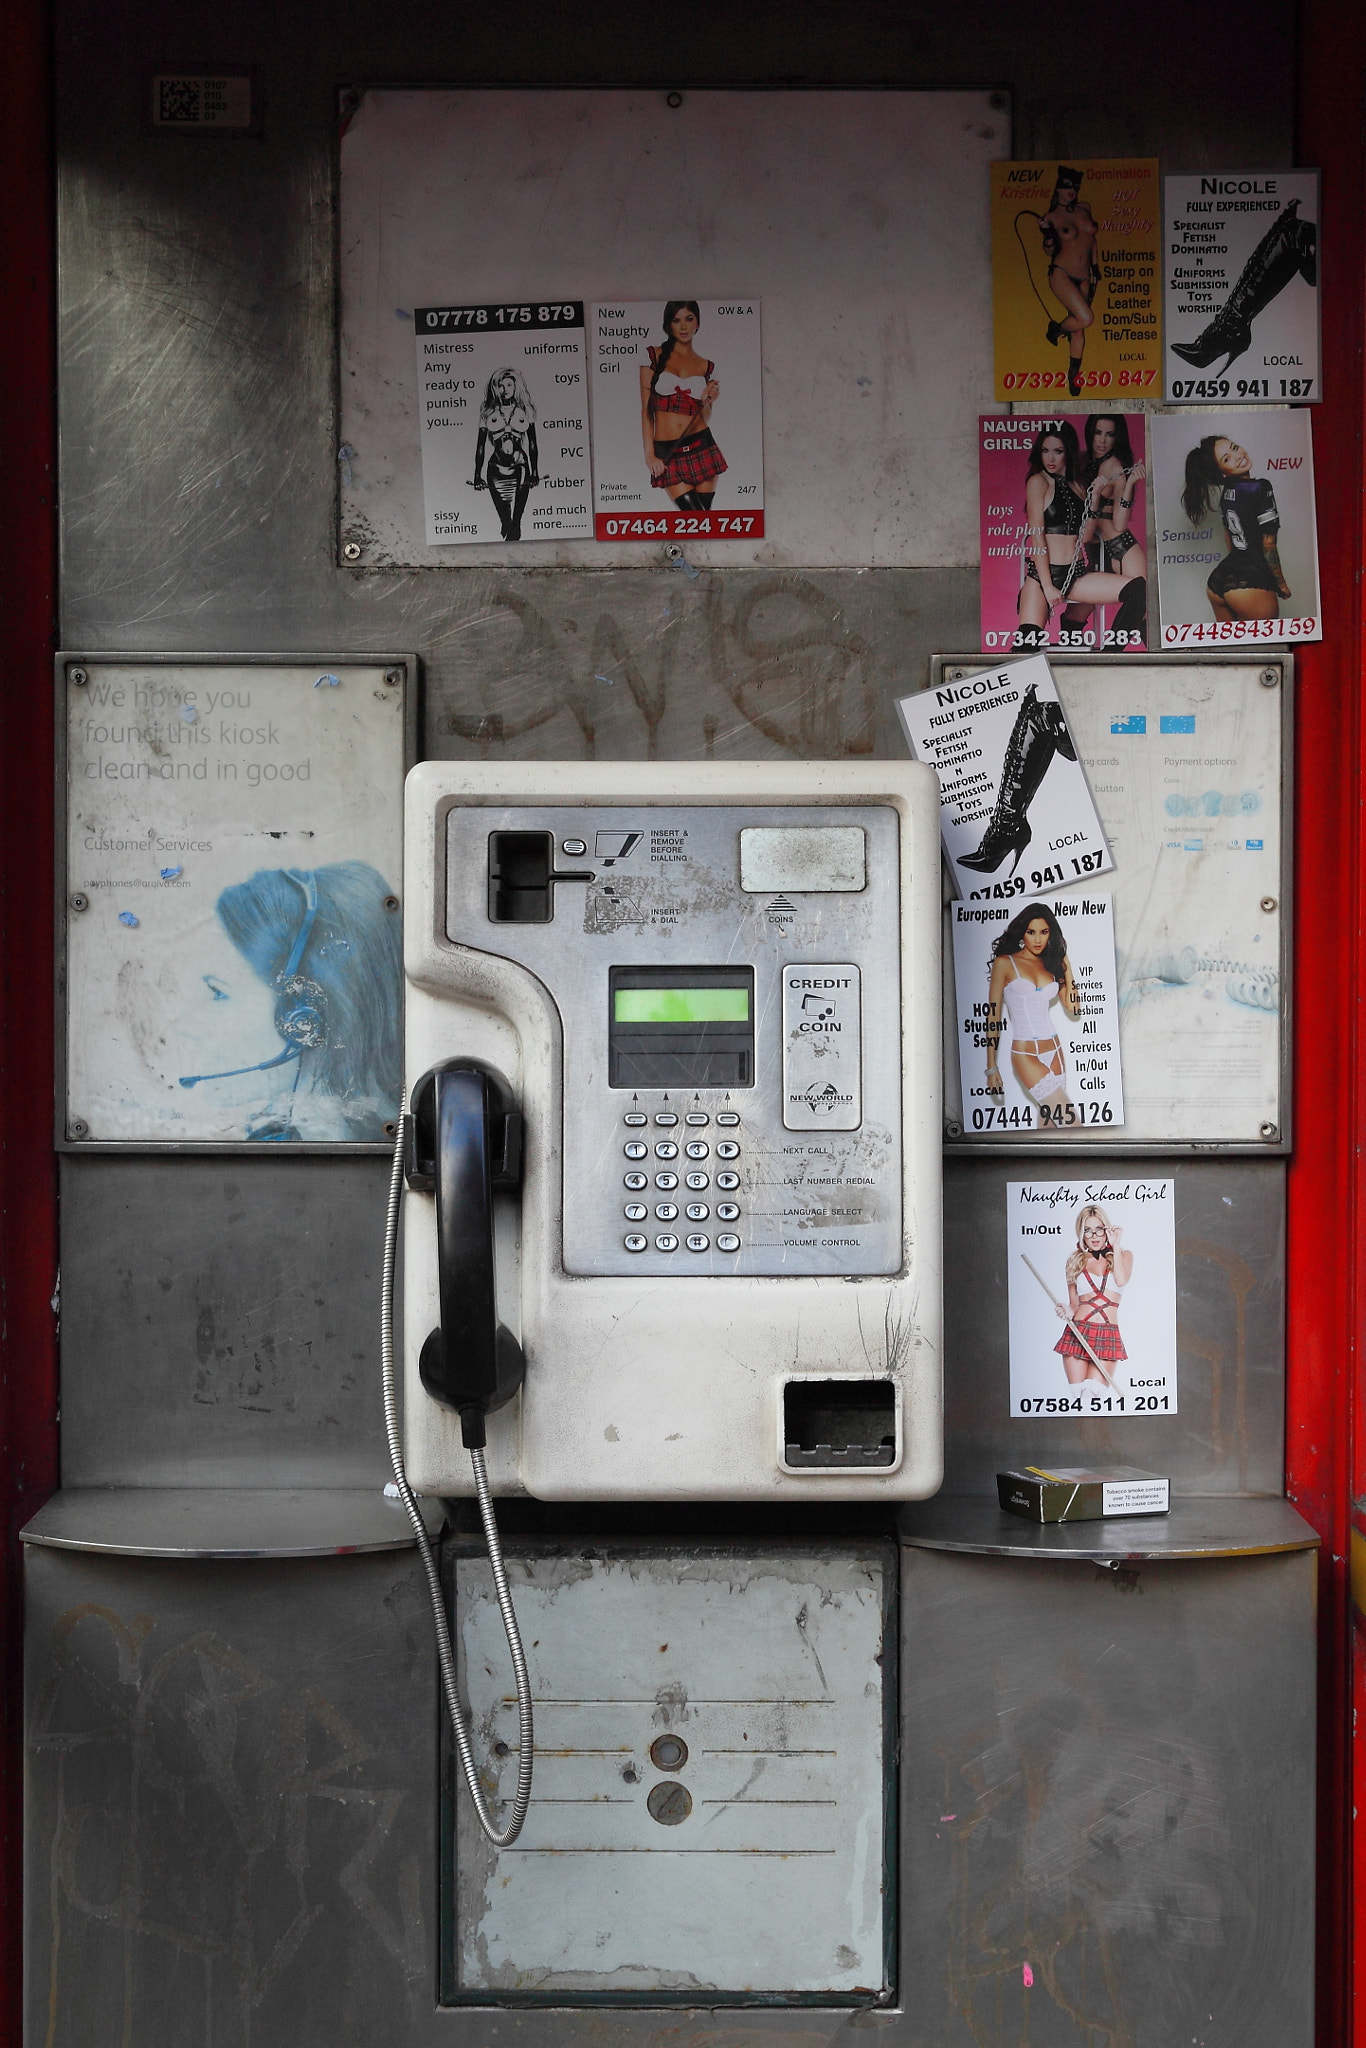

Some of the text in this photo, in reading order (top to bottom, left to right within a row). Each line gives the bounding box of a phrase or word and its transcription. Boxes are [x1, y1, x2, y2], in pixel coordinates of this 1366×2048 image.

[1007, 169, 1044, 183] NEW
[1086, 167, 1151, 181] Domination
[1000, 185, 1051, 200] Kristine
[1111, 204, 1142, 218] Sexy
[1186, 200, 1281, 213] FULLY EXPERIENCED
[1100, 217, 1154, 234] Naughty
[1101, 249, 1156, 262] Uniforms
[1103, 266, 1154, 280] Starp on
[1108, 281, 1150, 296] Caning
[1107, 297, 1152, 310] Leather
[1177, 304, 1222, 314] WORSHIP
[426, 305, 575, 327] 07778 175 879
[598, 308, 625, 319] New
[717, 306, 754, 315] OW & A
[1102, 312, 1157, 325] Dom/Sub
[599, 325, 650, 339] Naughty
[1102, 329, 1158, 341] Tie/Tease
[423, 344, 474, 354] Mistress
[524, 343, 579, 355] uniforms
[599, 343, 638, 355] School
[1119, 353, 1147, 362] LOCAL
[1263, 355, 1303, 366] LOCAL
[424, 362, 451, 374] Amy
[599, 362, 620, 373] Girl
[425, 380, 475, 392] ready to
[555, 373, 580, 386] toys
[1003, 369, 1159, 390] 07392 650 847
[1172, 378, 1314, 398] 07459 941 187
[426, 397, 467, 412] punish
[542, 418, 583, 430] caning
[983, 420, 1065, 433] NAUGHTY
[983, 438, 1034, 451] GIRLS
[561, 447, 584, 458] PVC
[1266, 457, 1303, 471] NEW
[544, 477, 585, 489] rubber
[600, 483, 628, 491] Private
[737, 485, 757, 494] 24/7
[600, 493, 642, 502] apartment
[434, 511, 460, 521] sissy
[532, 504, 587, 516] and much
[987, 504, 1014, 520] toys
[434, 524, 478, 535] training
[605, 516, 755, 535] 07464 224 747
[987, 522, 1045, 539] role play
[1162, 527, 1213, 542] Sensual
[987, 543, 1047, 560] uniforms
[1162, 552, 1222, 565] massage
[1165, 616, 1316, 642] 07448843159
[985, 629, 1142, 647] 07342 350 283
[85, 683, 251, 715] We hope you
[929, 690, 1020, 729] FULLY EXPERIENCED
[85, 719, 280, 745] found this kiosk
[1096, 757, 1120, 766] cards
[1164, 757, 1237, 768] Payment options
[84, 755, 311, 788] clean and in good
[1095, 784, 1124, 793] button
[84, 836, 213, 851] Customer Services
[1048, 831, 1088, 851] LOCAL
[650, 846, 683, 854] BEFORE
[1030, 863, 1065, 889] 941
[1071, 849, 1103, 875] 187
[650, 908, 680, 916] INSERT
[956, 900, 1107, 924] European New New
[1078, 966, 1094, 977] VIP
[789, 979, 852, 989] CREDIT
[1071, 980, 1103, 990] Services
[1069, 991, 1106, 1003] Uniforms
[972, 1003, 997, 1017] HOT
[1073, 1005, 1104, 1017] Lesbian
[799, 1022, 842, 1032] COIN
[964, 1018, 1008, 1033] Student
[1082, 1021, 1097, 1034] All
[973, 1033, 1000, 1051] Sexy
[1069, 1041, 1112, 1054] Services
[1075, 1059, 1108, 1072] In/Out
[1079, 1077, 1106, 1090] Calls
[970, 1087, 1005, 1097] LOCAL
[972, 1105, 1033, 1130] 07444
[1039, 1101, 1113, 1127] 945126
[1020, 1183, 1167, 1208] Naughty School Girl
[783, 1208, 863, 1216] LANGUAGE SELECT
[1021, 1225, 1062, 1236] In/Out
[1130, 1377, 1166, 1388] Local
[1020, 1395, 1169, 1413] 07584 511 201
